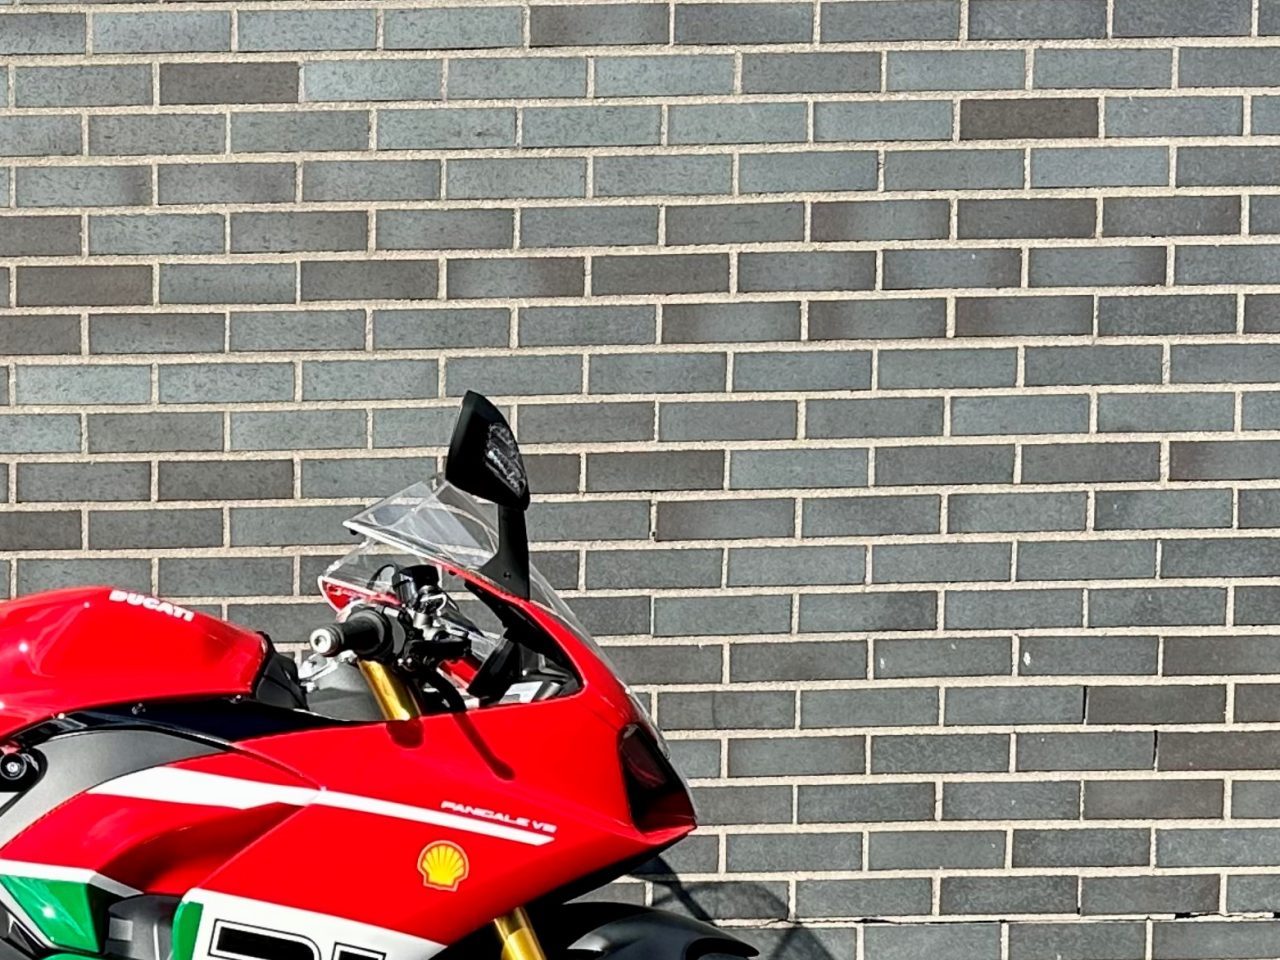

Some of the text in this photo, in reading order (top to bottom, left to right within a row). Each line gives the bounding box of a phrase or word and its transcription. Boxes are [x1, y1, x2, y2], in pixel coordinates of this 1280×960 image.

[109, 590, 195, 622] DUCATI
[441, 800, 557, 833] PANIGALE V2
